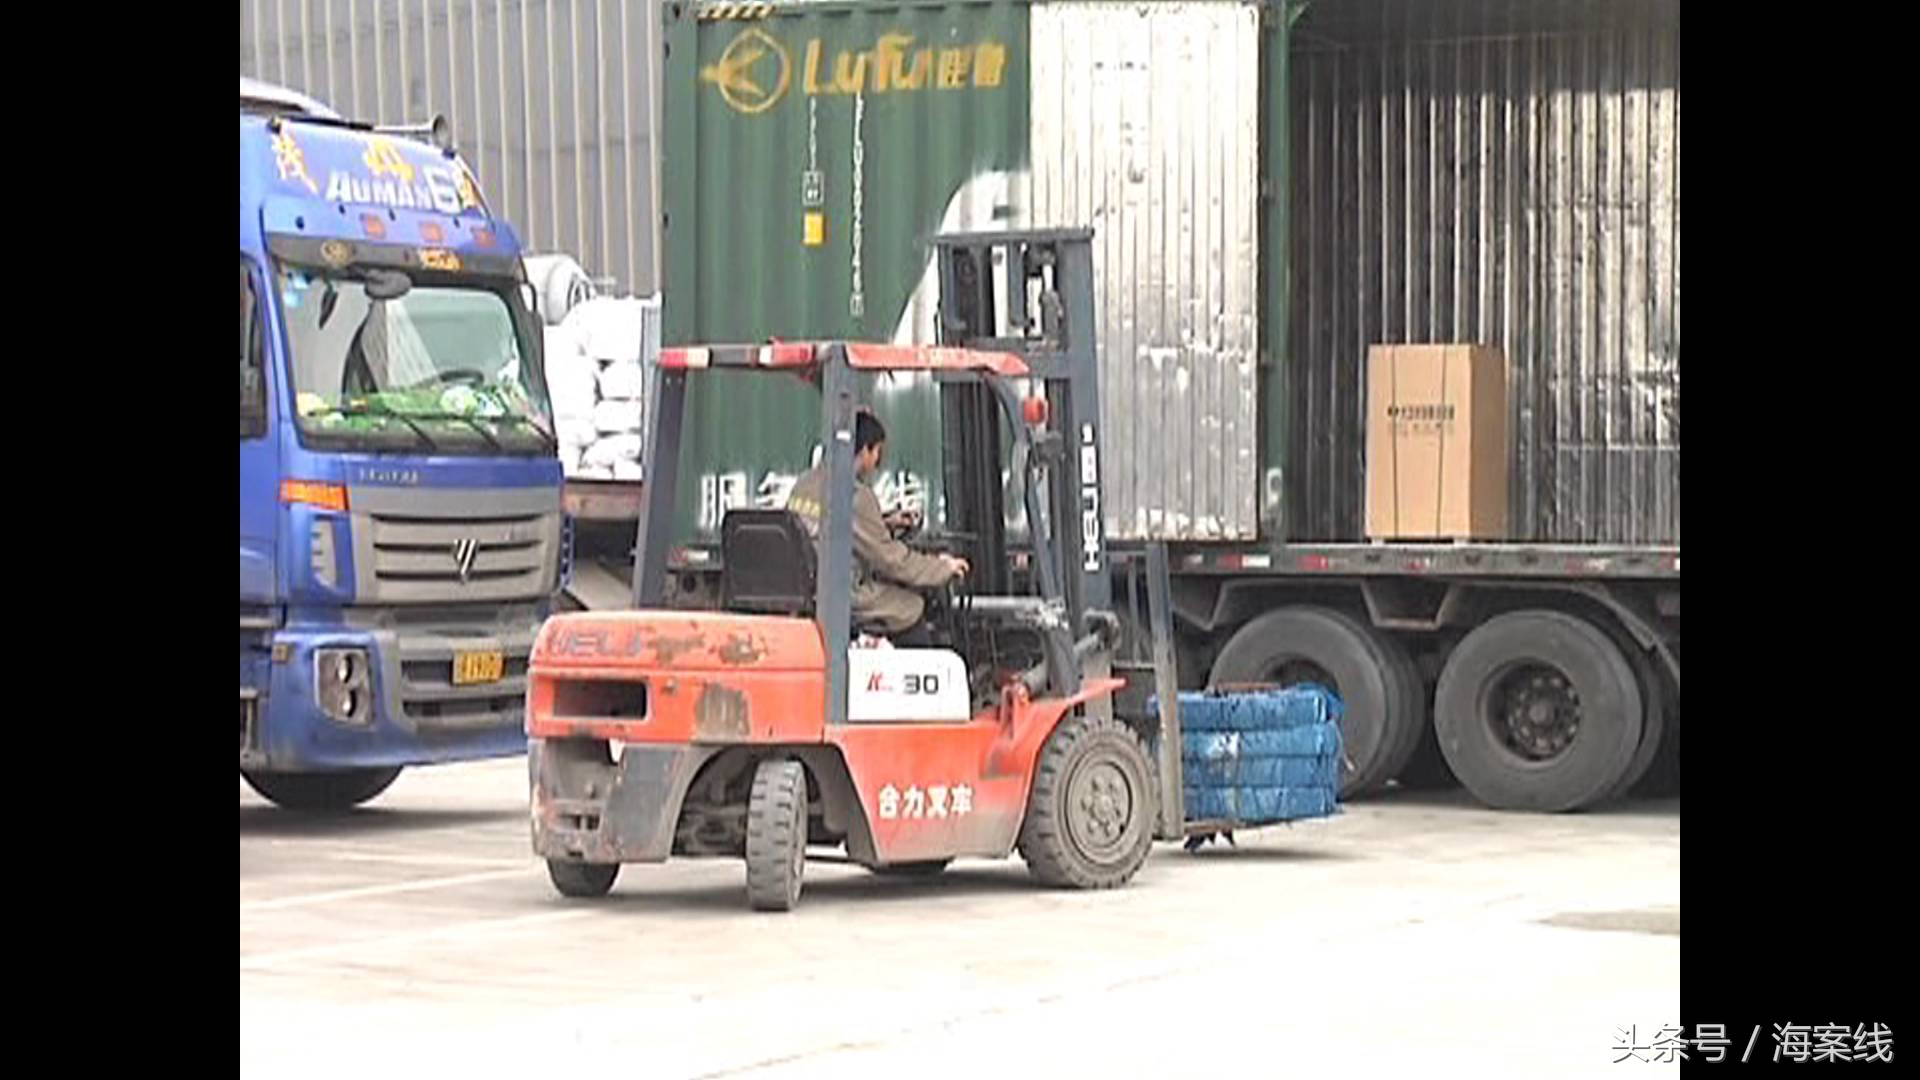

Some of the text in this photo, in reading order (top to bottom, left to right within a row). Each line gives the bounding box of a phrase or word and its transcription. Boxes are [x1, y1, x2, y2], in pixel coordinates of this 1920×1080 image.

[903, 674, 939, 695] 30
[878, 783, 973, 819] 合力叉车
